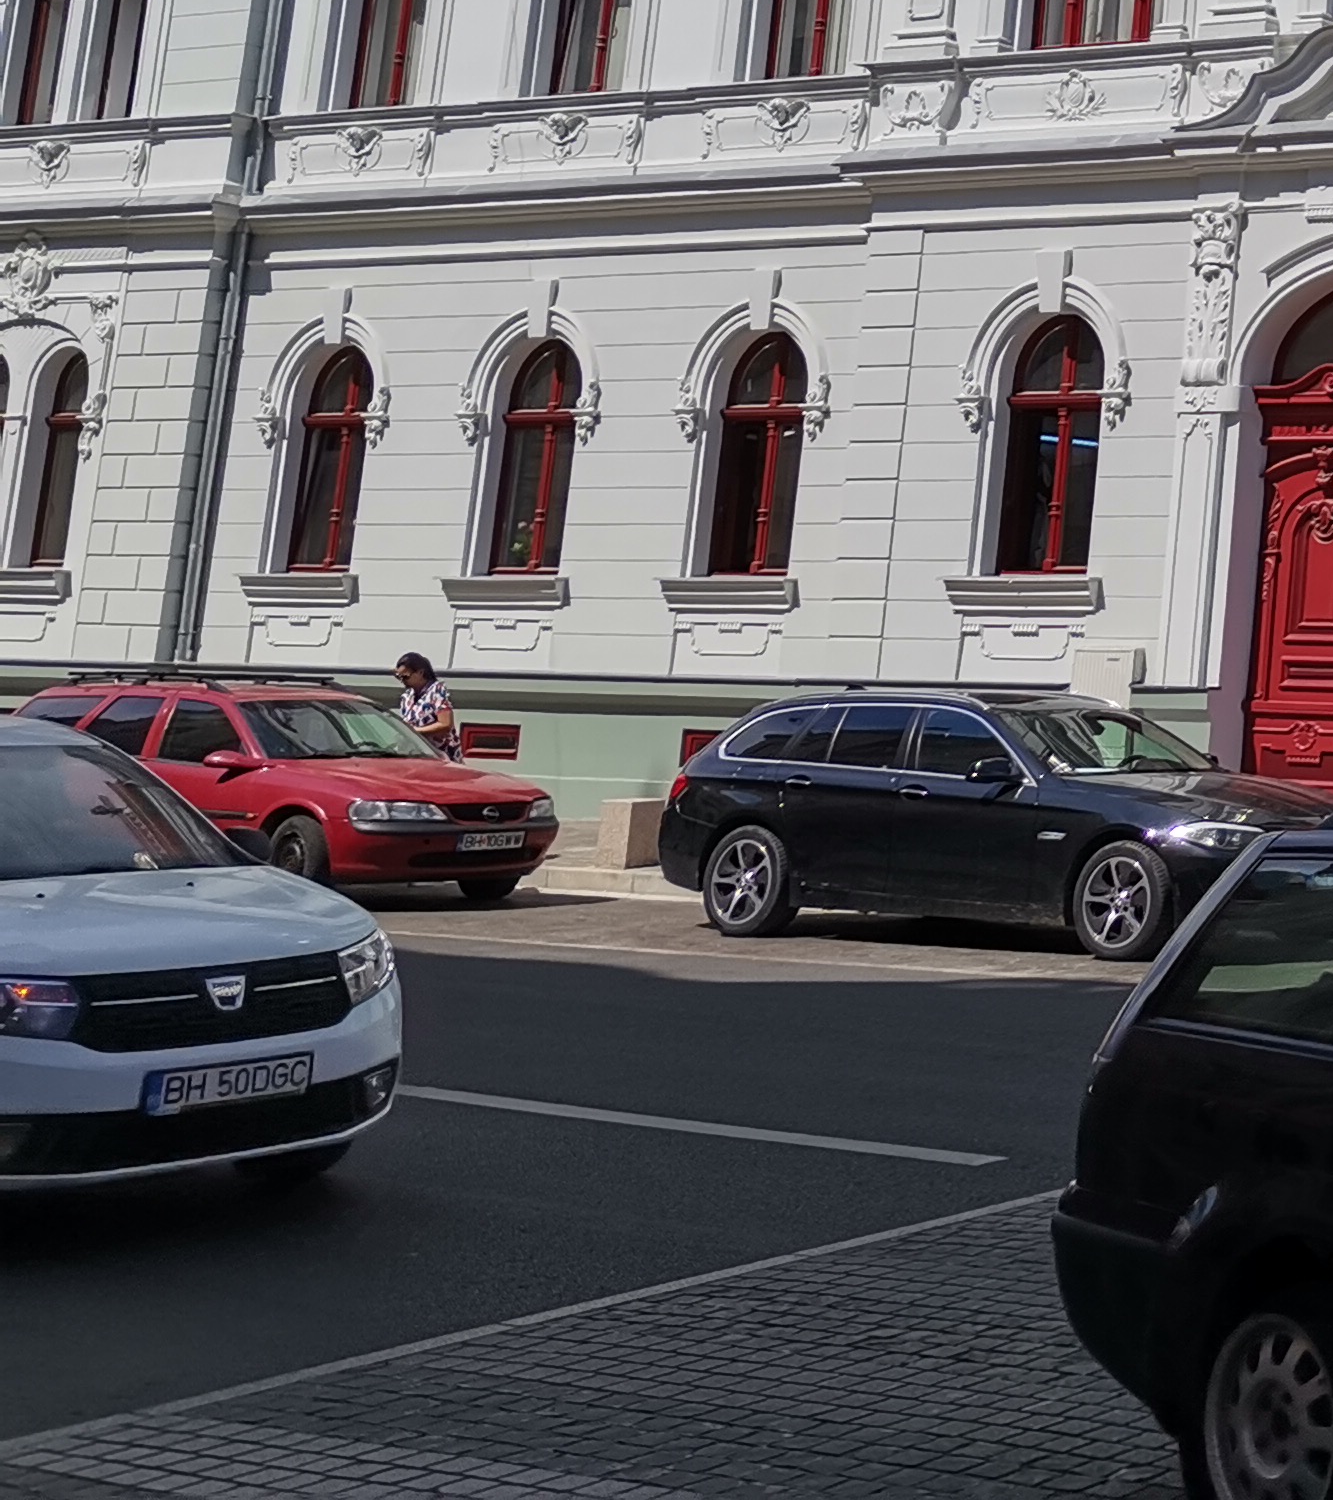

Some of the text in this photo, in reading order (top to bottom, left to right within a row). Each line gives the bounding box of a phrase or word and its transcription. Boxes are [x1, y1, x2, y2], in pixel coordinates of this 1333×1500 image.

[463, 835, 482, 849] BH
[163, 1072, 208, 1105] BH
[216, 1059, 307, 1097] 50DGC
